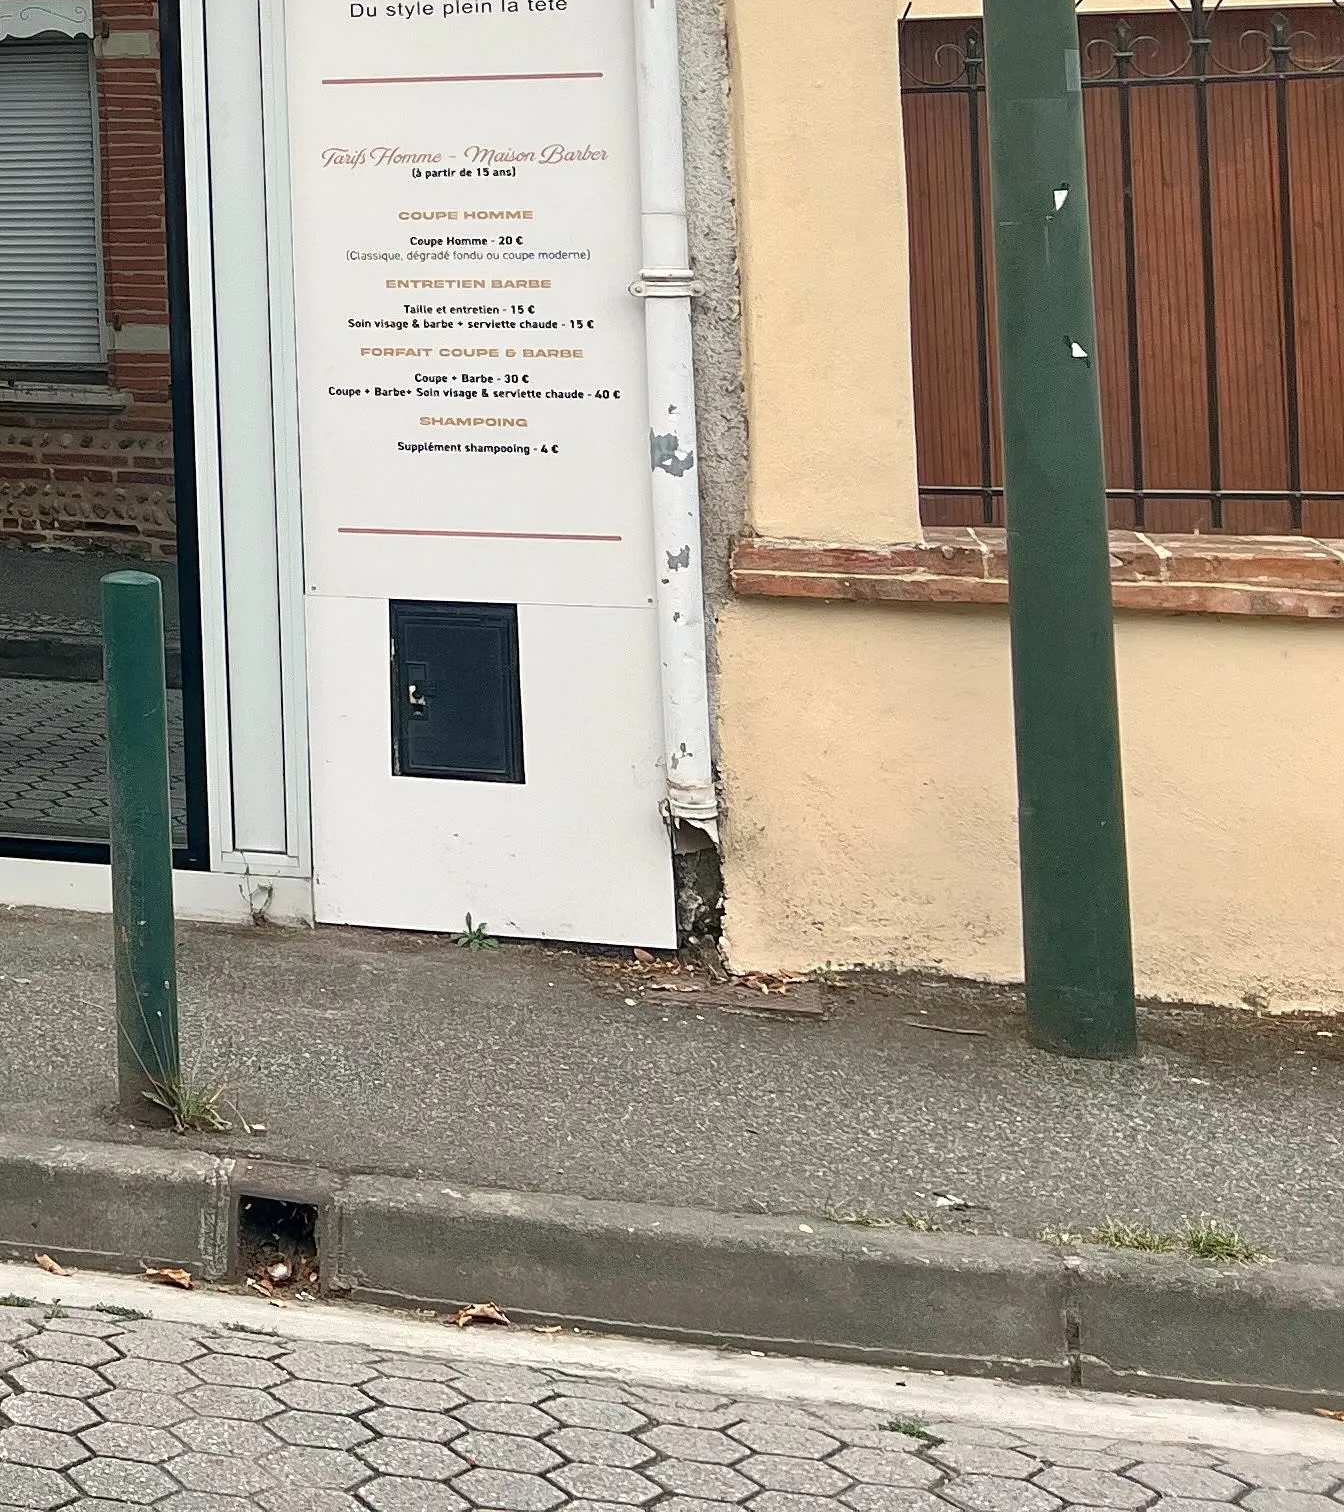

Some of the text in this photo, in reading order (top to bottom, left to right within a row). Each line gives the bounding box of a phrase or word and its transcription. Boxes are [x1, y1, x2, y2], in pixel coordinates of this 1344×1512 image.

[351, 4, 376, 17] Du
[386, 1, 433, 19] style
[444, 0, 491, 18] plein
[321, 143, 610, 171] Tarifs Homme Maison Barber
[412, 166, 515, 179] (à partir de 15 ans)
[399, 211, 533, 220] COUPE HOMME
[410, 236, 523, 247] Coupe Homme 20 €
[347, 250, 403, 262] (Classique,
[407, 250, 450, 262] dégradé
[453, 251, 483, 260] fondu
[503, 253, 535, 261] coupe
[538, 249, 590, 260] moderne)
[386, 280, 551, 288] ENTRETIEN BARBE
[404, 305, 535, 314] Taille et entretien 15 €
[348, 319, 371, 327] Soin
[374, 319, 408, 330] visage
[412, 319, 420, 328] &
[424, 319, 453, 328] barbe
[468, 320, 516, 328] serviette
[520, 320, 557, 328] chaude
[570, 320, 583, 328] 15
[587, 320, 594, 329] €
[360, 348, 583, 358] FORFAIT COUPE & BARBE
[415, 374, 447, 384] Coupe
[462, 374, 493, 383] Barbe
[505, 374, 518, 383] 30
[522, 375, 529, 383] €
[329, 387, 361, 397] Coupe
[416, 388, 439, 396] Soin
[443, 388, 477, 399] visage
[482, 389, 489, 397] &
[493, 389, 541, 398] serviette
[546, 389, 584, 399] chaude
[595, 390, 609, 399] 40
[613, 390, 620, 399] €
[420, 417, 527, 427] SHAMPOING
[398, 442, 559, 455] Supplément shampooing 4 €
